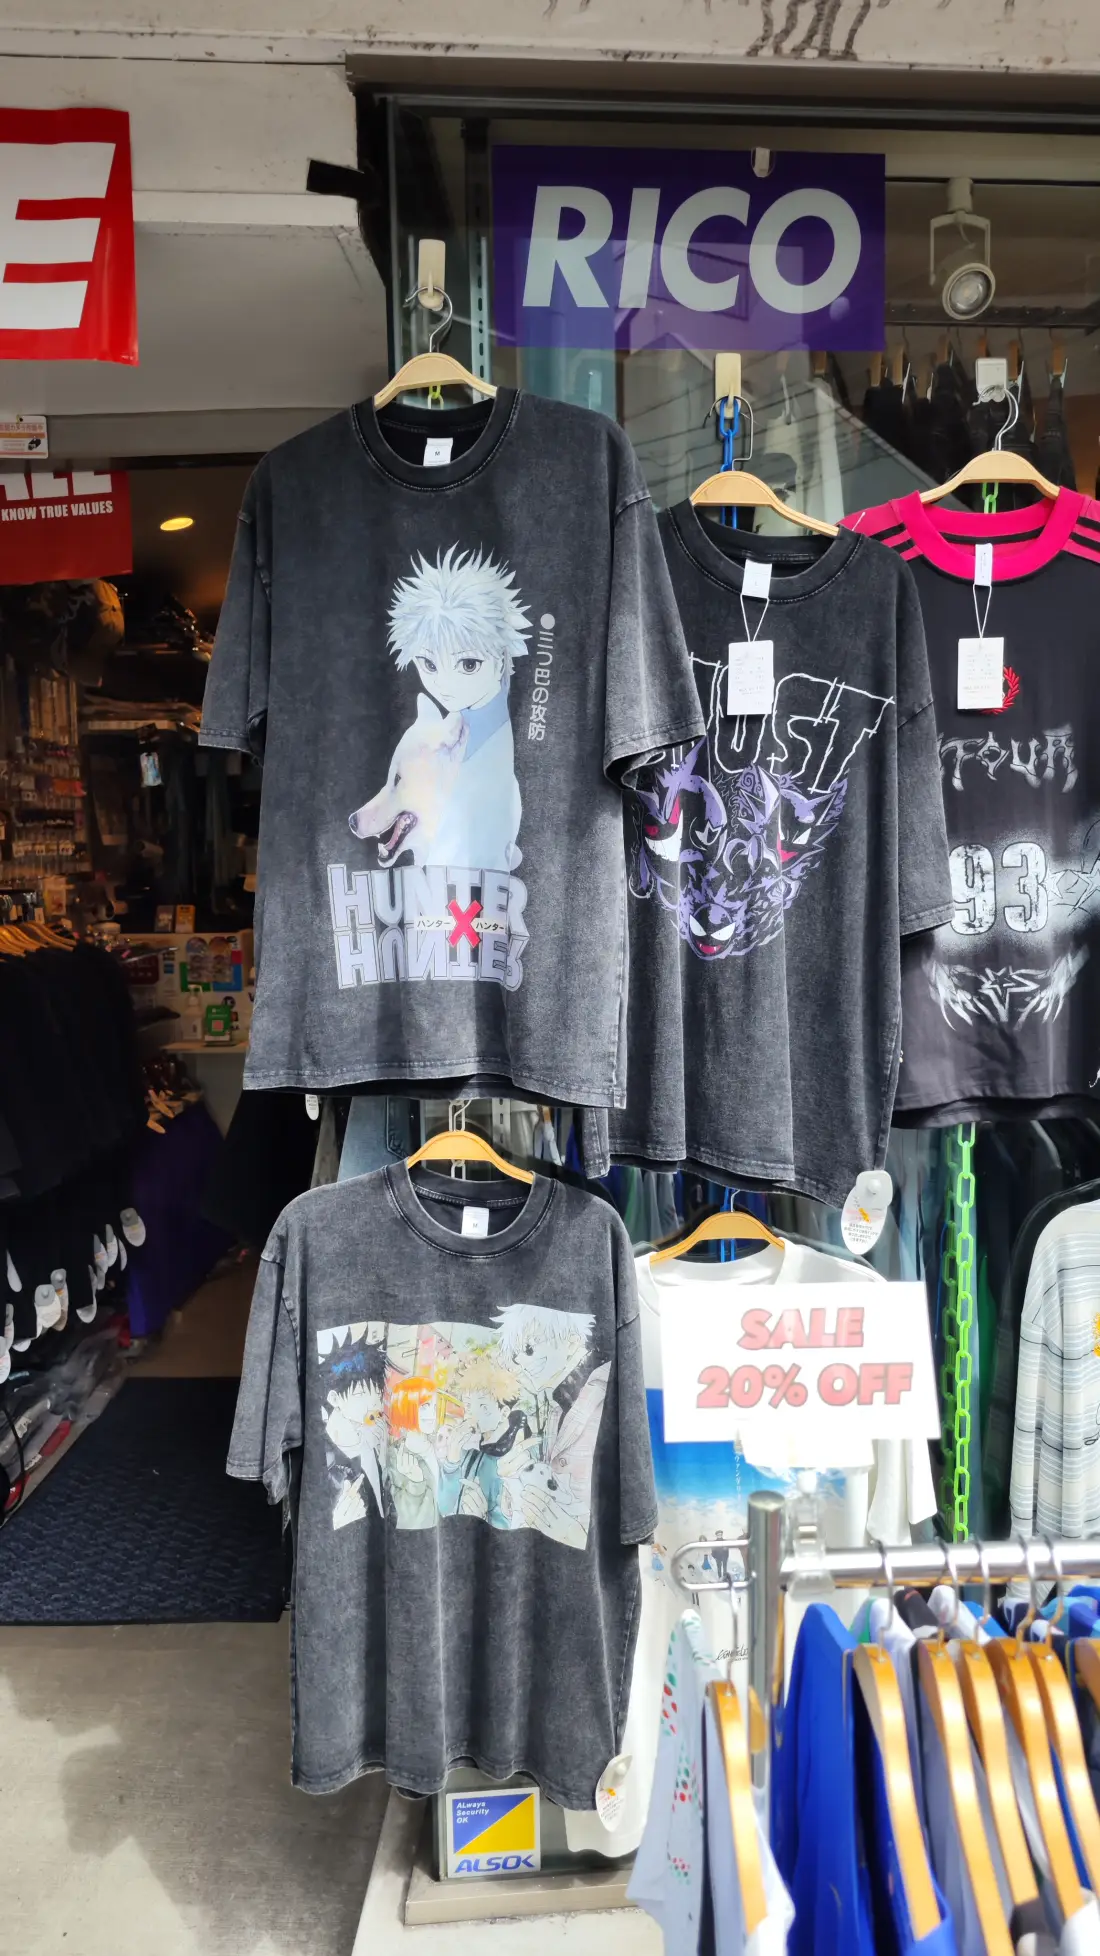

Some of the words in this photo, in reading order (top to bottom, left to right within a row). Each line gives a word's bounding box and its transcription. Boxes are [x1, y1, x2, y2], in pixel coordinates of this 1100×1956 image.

[523, 185, 862, 314] RICO
[1, 507, 37, 522] KNOW
[40, 504, 69, 519] TRUE
[71, 500, 114, 516] VALUES
[327, 864, 530, 936] HUNTER
[950, 842, 1052, 935] 93
[416, 919, 452, 928] ハンター
[475, 922, 505, 931] ハンター
[736, 1306, 865, 1350] SALE
[696, 1362, 809, 1409] 20%
[817, 1362, 914, 1407] OFF
[456, 1808, 489, 1816] Security
[456, 1816, 469, 1824] OK
[455, 1854, 536, 1873] ALSOK
